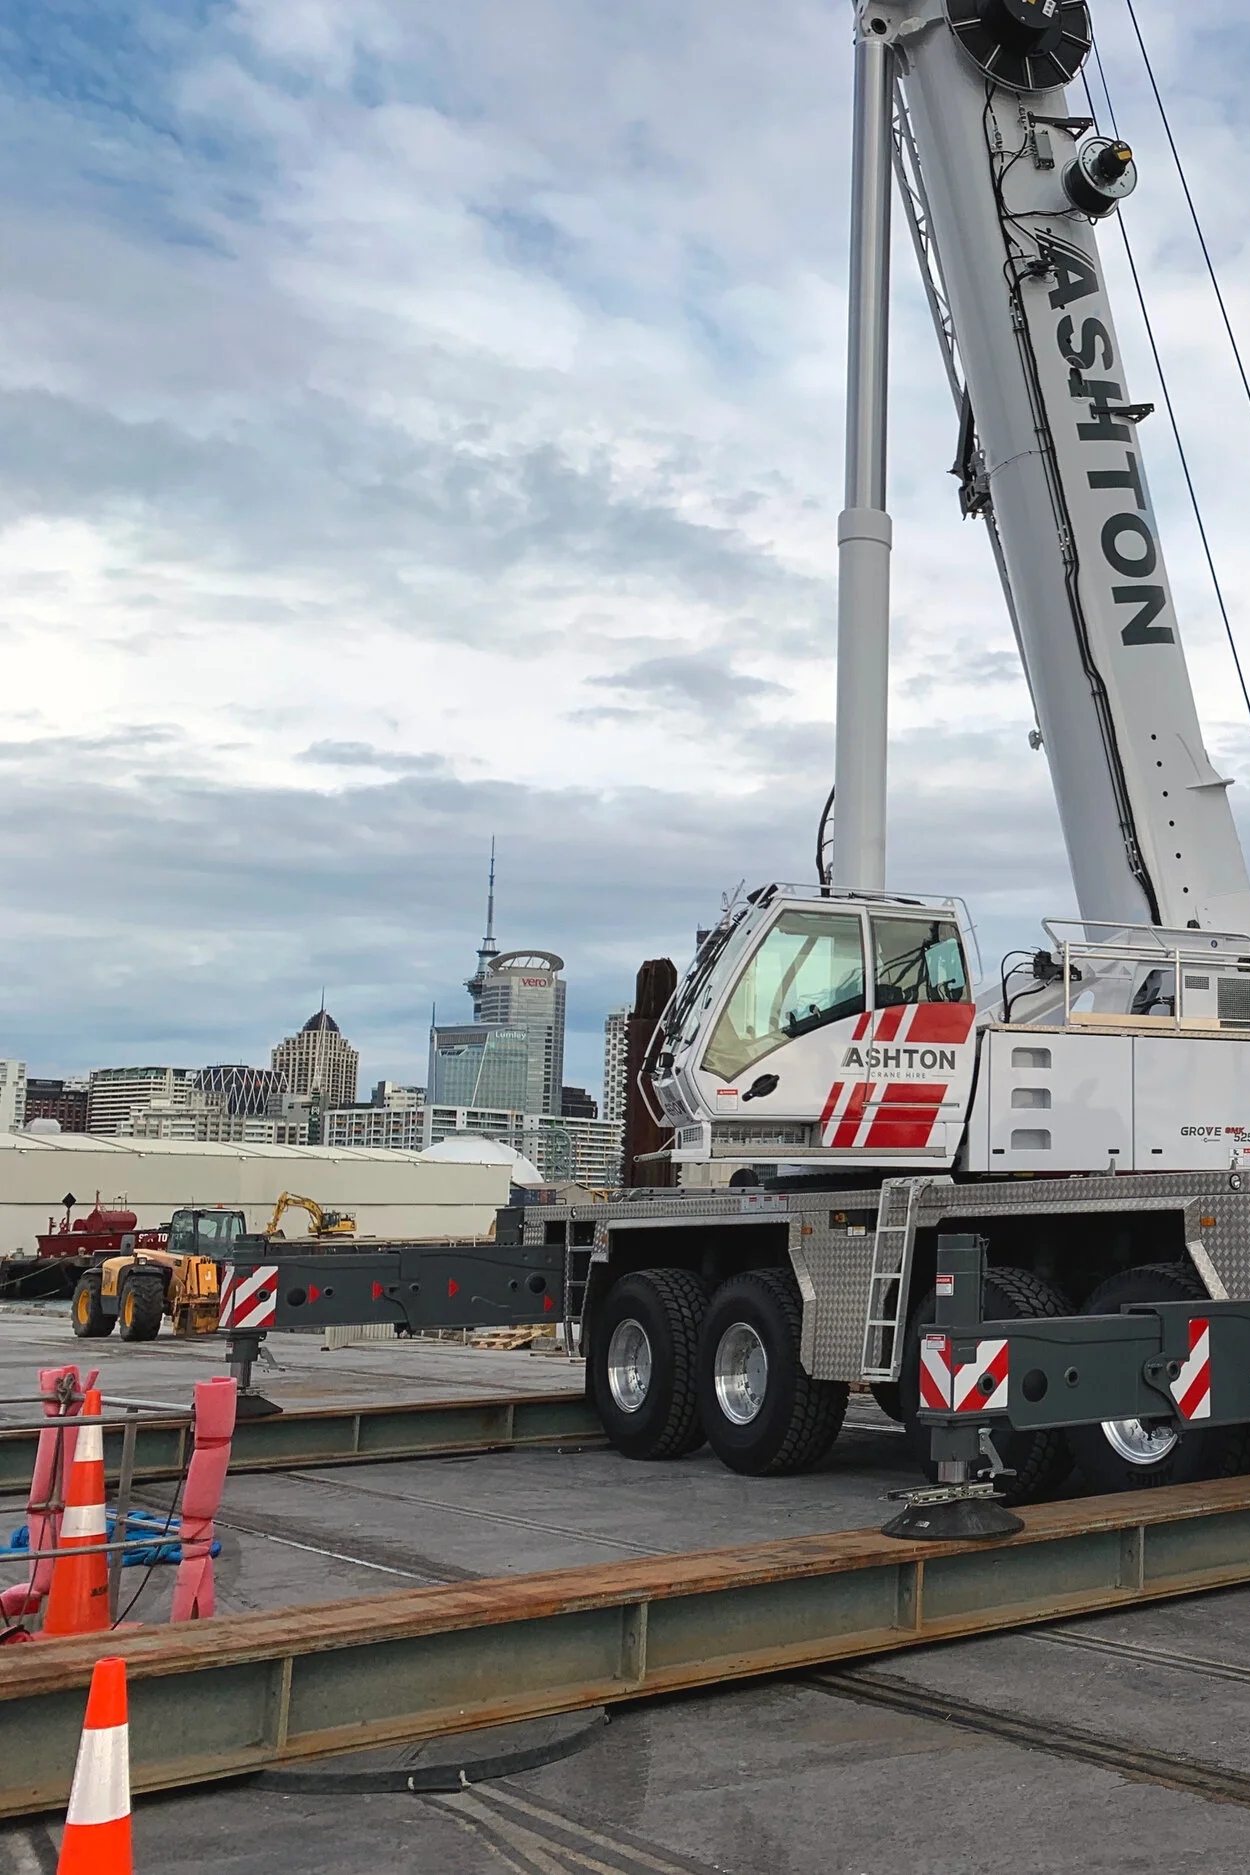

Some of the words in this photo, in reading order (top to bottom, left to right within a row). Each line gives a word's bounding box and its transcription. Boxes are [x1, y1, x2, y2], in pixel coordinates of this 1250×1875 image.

[1034, 227, 1175, 646] ASHTON
[522, 978, 546, 987] vero
[495, 1031, 526, 1039] Lumley
[841, 1047, 955, 1070] ASHTON
[1180, 1127, 1222, 1136] GROVE
